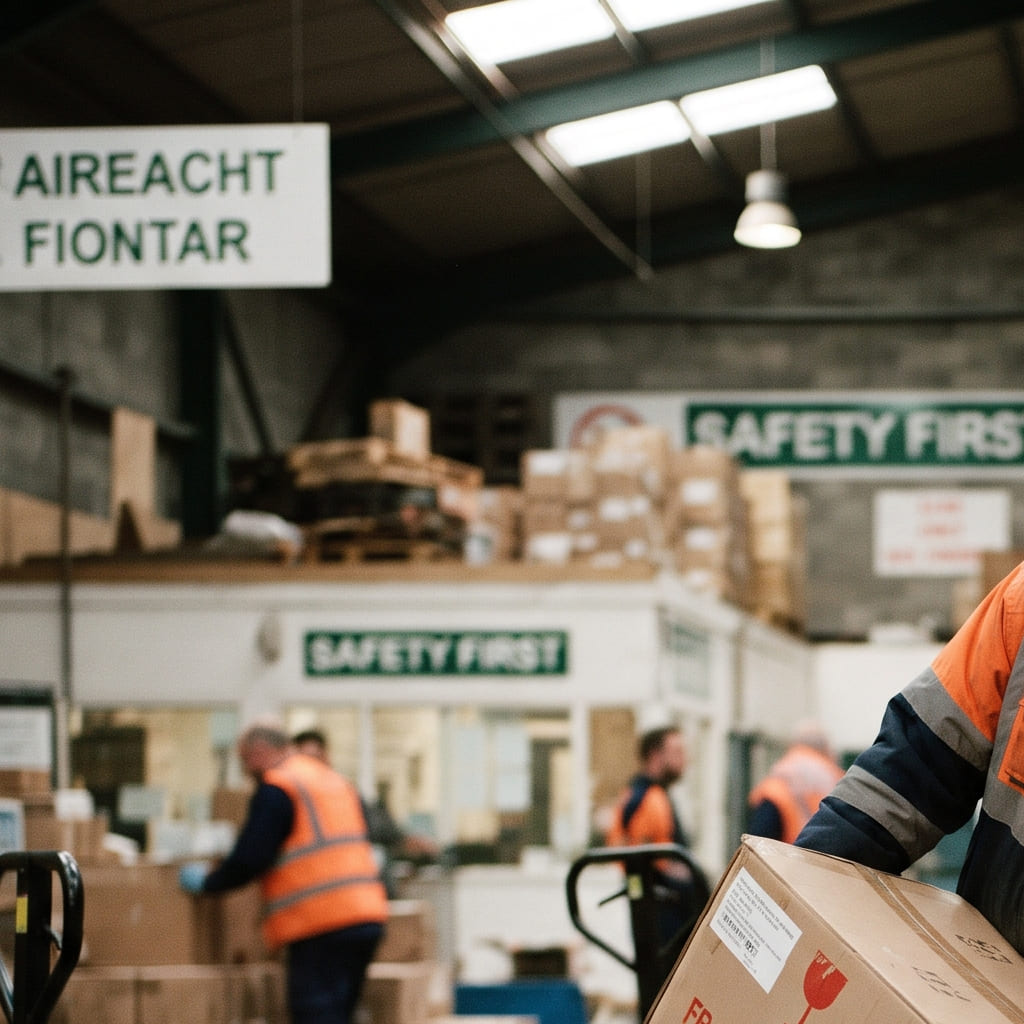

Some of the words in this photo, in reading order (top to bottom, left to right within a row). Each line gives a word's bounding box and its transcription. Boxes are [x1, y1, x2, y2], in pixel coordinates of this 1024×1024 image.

[15, 150, 284, 197] AIREACHT
[24, 218, 251, 265] FIONTAR
[693, 411, 898, 460] SAFETY
[309, 635, 450, 671] SAFETY
[456, 635, 562, 671] FIRST
